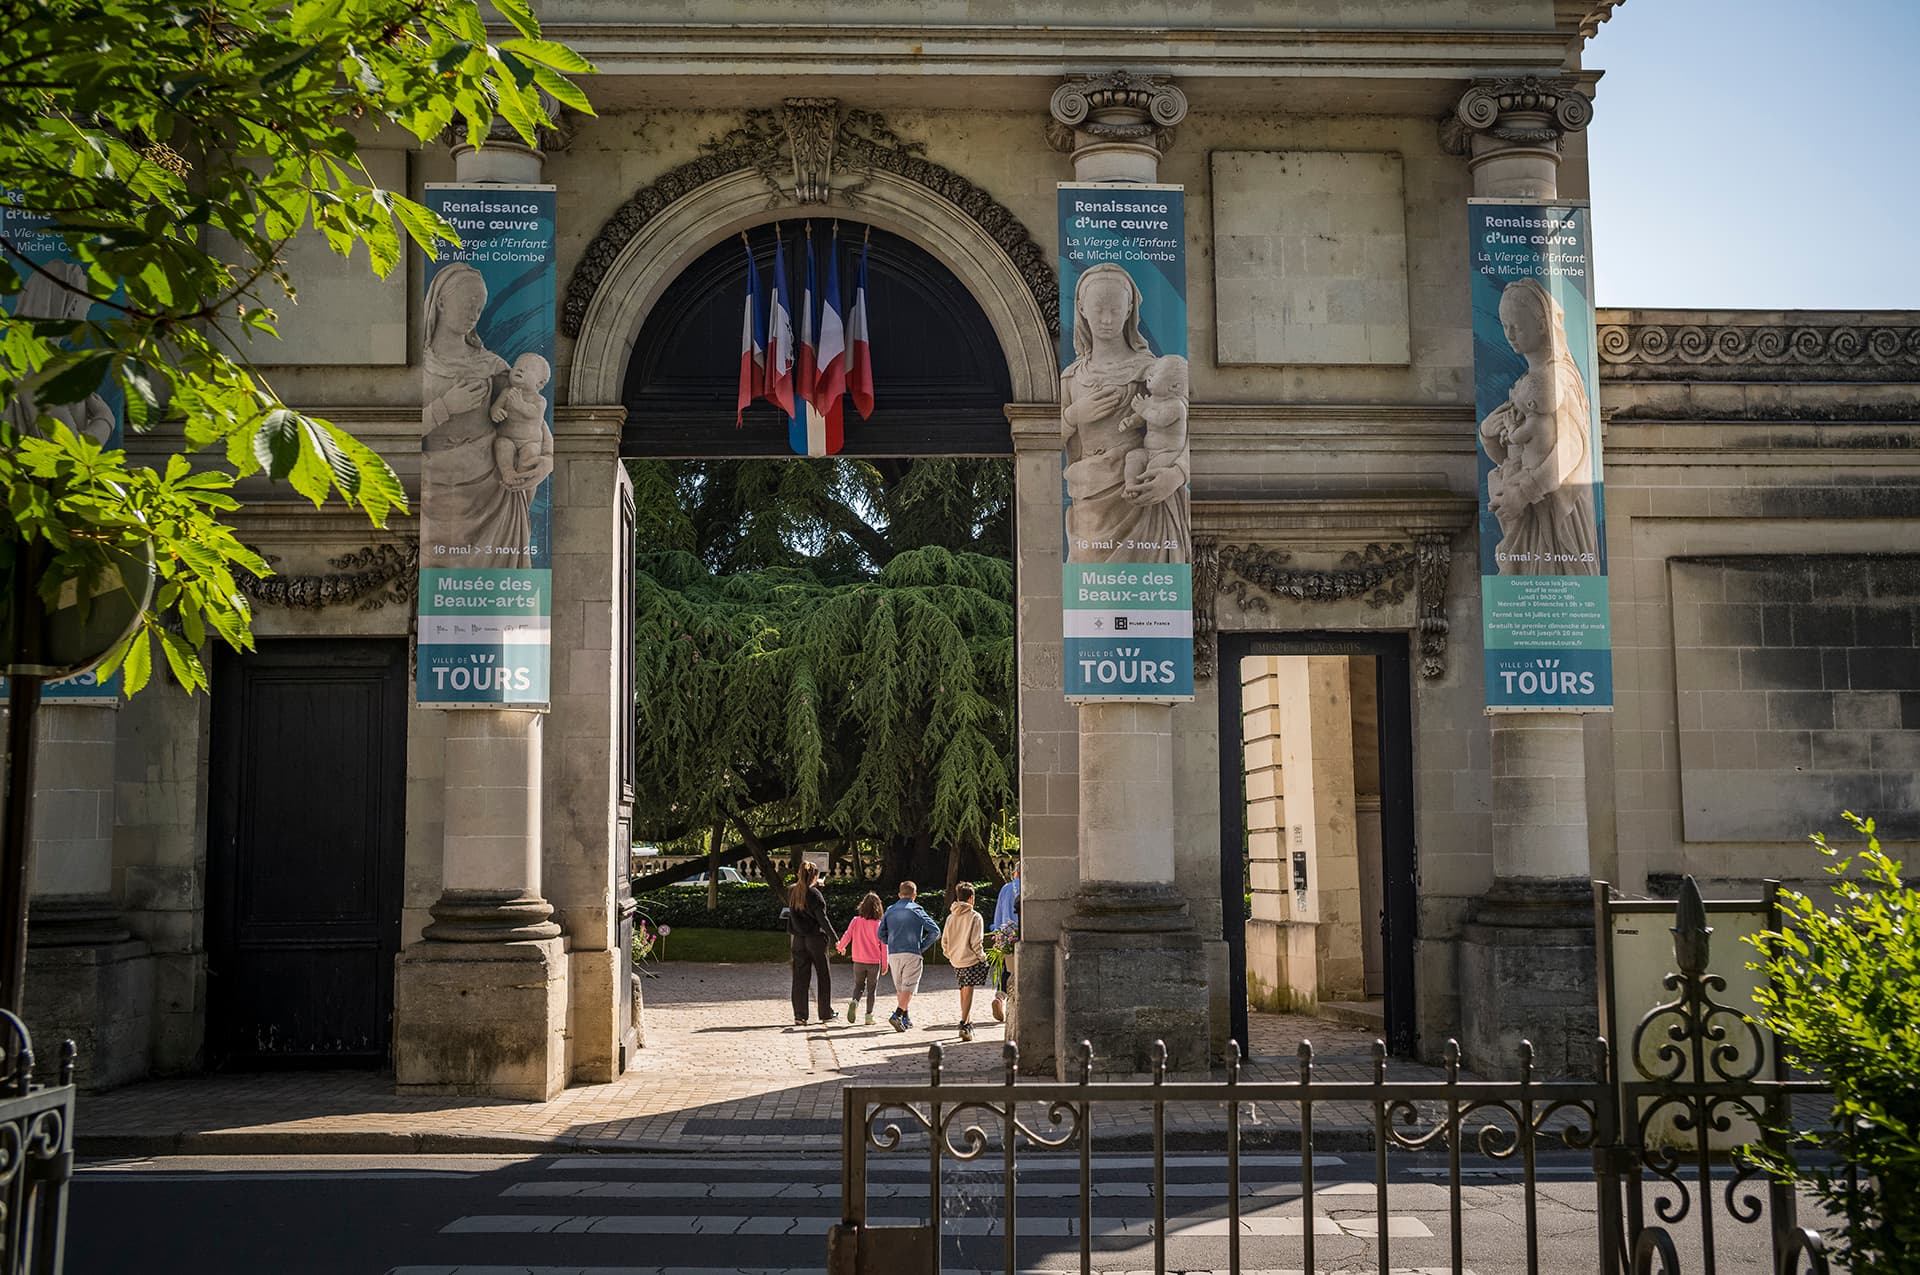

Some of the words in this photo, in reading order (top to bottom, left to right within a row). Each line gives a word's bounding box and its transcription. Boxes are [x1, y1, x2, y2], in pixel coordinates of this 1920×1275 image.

[442, 201, 539, 214] Renaissance
[1075, 200, 1168, 213] Renaissance
[489, 219, 538, 231] œuvre
[1075, 217, 1117, 229] d’une
[1121, 219, 1169, 230] œuvre
[1485, 216, 1576, 229] Renaissance
[489, 237, 498, 248] à
[500, 238, 548, 250] l’Enfant
[1066, 237, 1080, 247] La
[1083, 237, 1119, 249] Vierge
[1122, 236, 1130, 247] à
[1132, 237, 1177, 248] l’Enfant
[1486, 232, 1527, 244] d’une
[1531, 235, 1577, 246] œuvre
[436, 251, 450, 261] de
[453, 250, 489, 261] Michel
[492, 251, 545, 262] Colombe
[1069, 250, 1084, 260] de
[1087, 250, 1122, 260] Michel
[1124, 251, 1176, 262] Colombe
[1478, 252, 1491, 262] La
[1494, 252, 1529, 264] Vierge
[1532, 252, 1540, 262] à
[1542, 253, 1585, 264] l’Enfant
[1480, 265, 1495, 275] de
[1498, 265, 1533, 275] Michel
[1535, 266, 1585, 277] Colombe
[433, 545, 446, 555] 16
[448, 544, 471, 555] mai
[485, 545, 493, 555] 3
[495, 547, 520, 555] nov.
[523, 546, 538, 555] 25
[1076, 539, 1090, 550] 16
[1091, 539, 1113, 550] mai
[1127, 540, 1135, 550] 3
[1137, 541, 1161, 550] nov.
[1164, 540, 1178, 550] 25
[1495, 553, 1506, 563] 16
[1509, 552, 1531, 562] mai
[1544, 553, 1552, 562] 3
[1554, 554, 1577, 562] nov.
[1580, 553, 1594, 563] 25
[438, 577, 495, 591] Musée
[499, 577, 532, 591] des
[1082, 571, 1138, 586] Musée
[1142, 572, 1174, 586] des
[433, 594, 536, 608] Beaux-arts
[1079, 588, 1178, 602] Beaux-arts
[1079, 660, 1175, 683] TOURS
[431, 667, 530, 690] TOURS
[1500, 671, 1595, 694] TOURS
